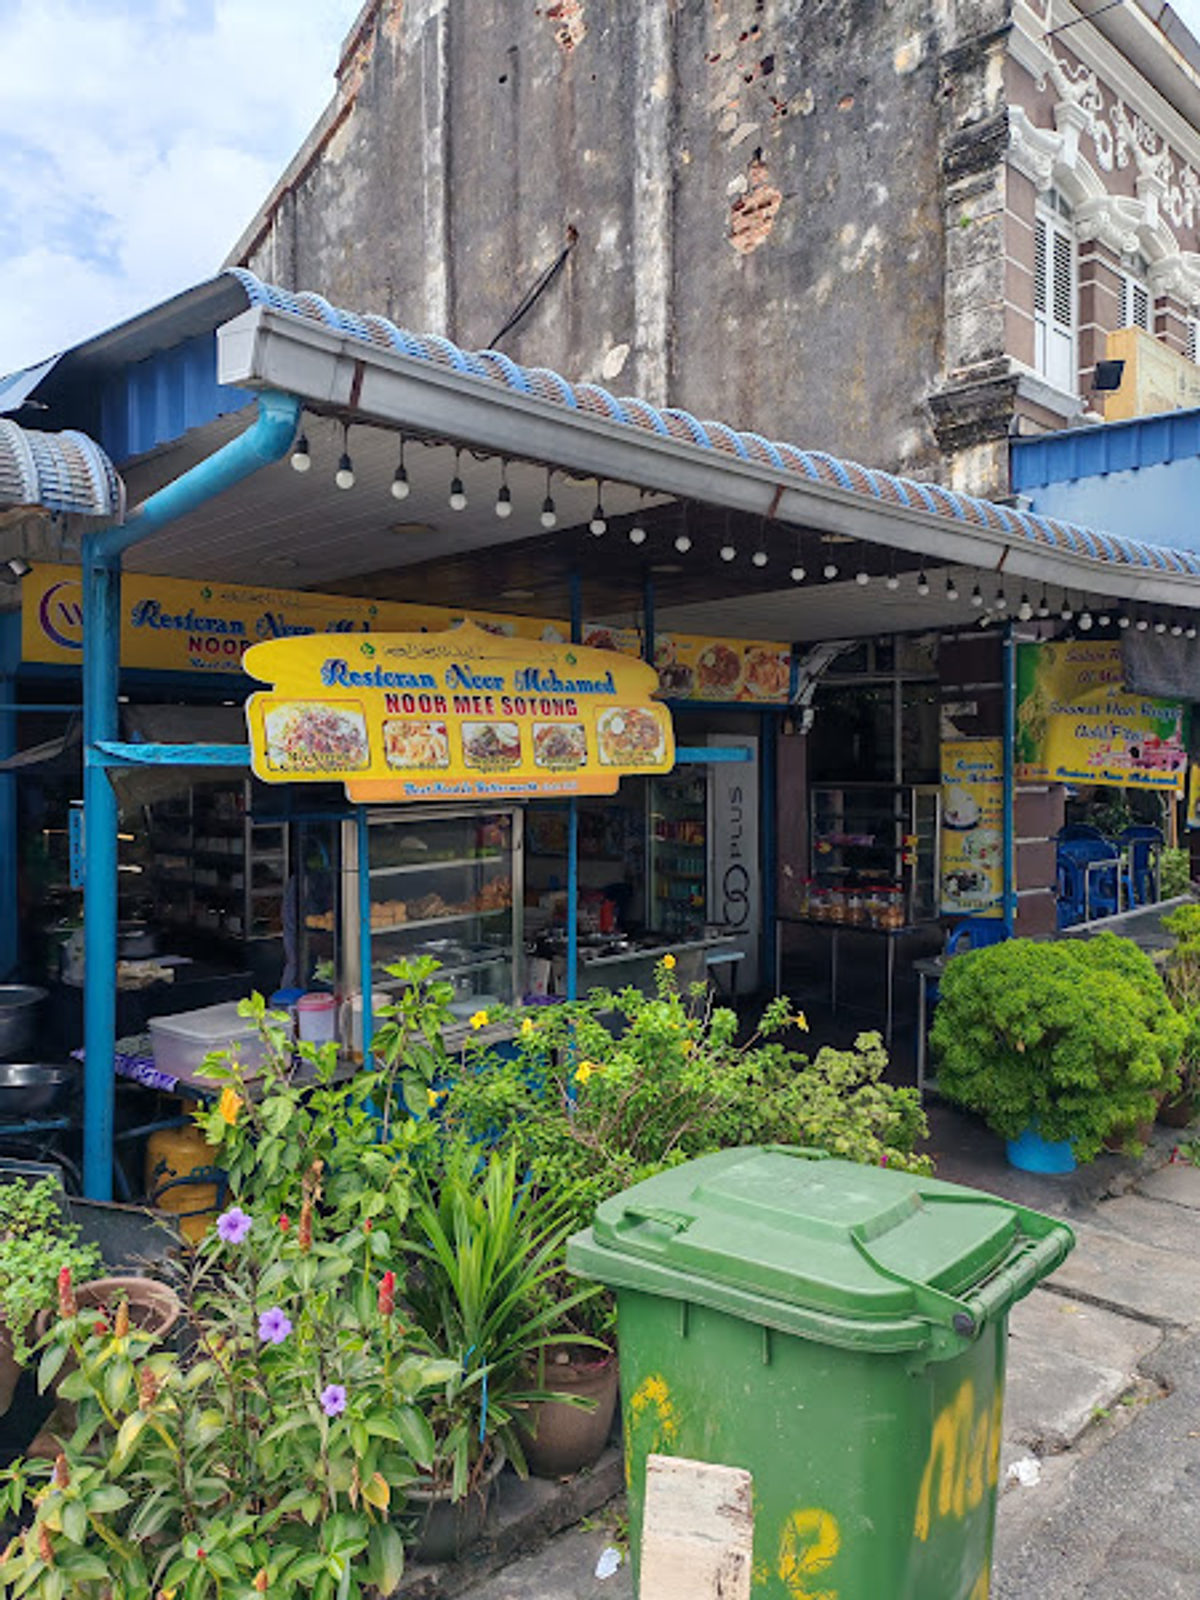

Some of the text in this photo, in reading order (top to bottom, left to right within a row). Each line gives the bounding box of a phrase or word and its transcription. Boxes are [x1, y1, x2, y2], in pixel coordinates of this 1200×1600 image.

[131, 599, 245, 635] Restoran
[320, 658, 617, 695] Restoran Noor Mohamed
[384, 693, 578, 716] NOOR MEE SOTONG
[730, 785, 743, 858] PLUS
